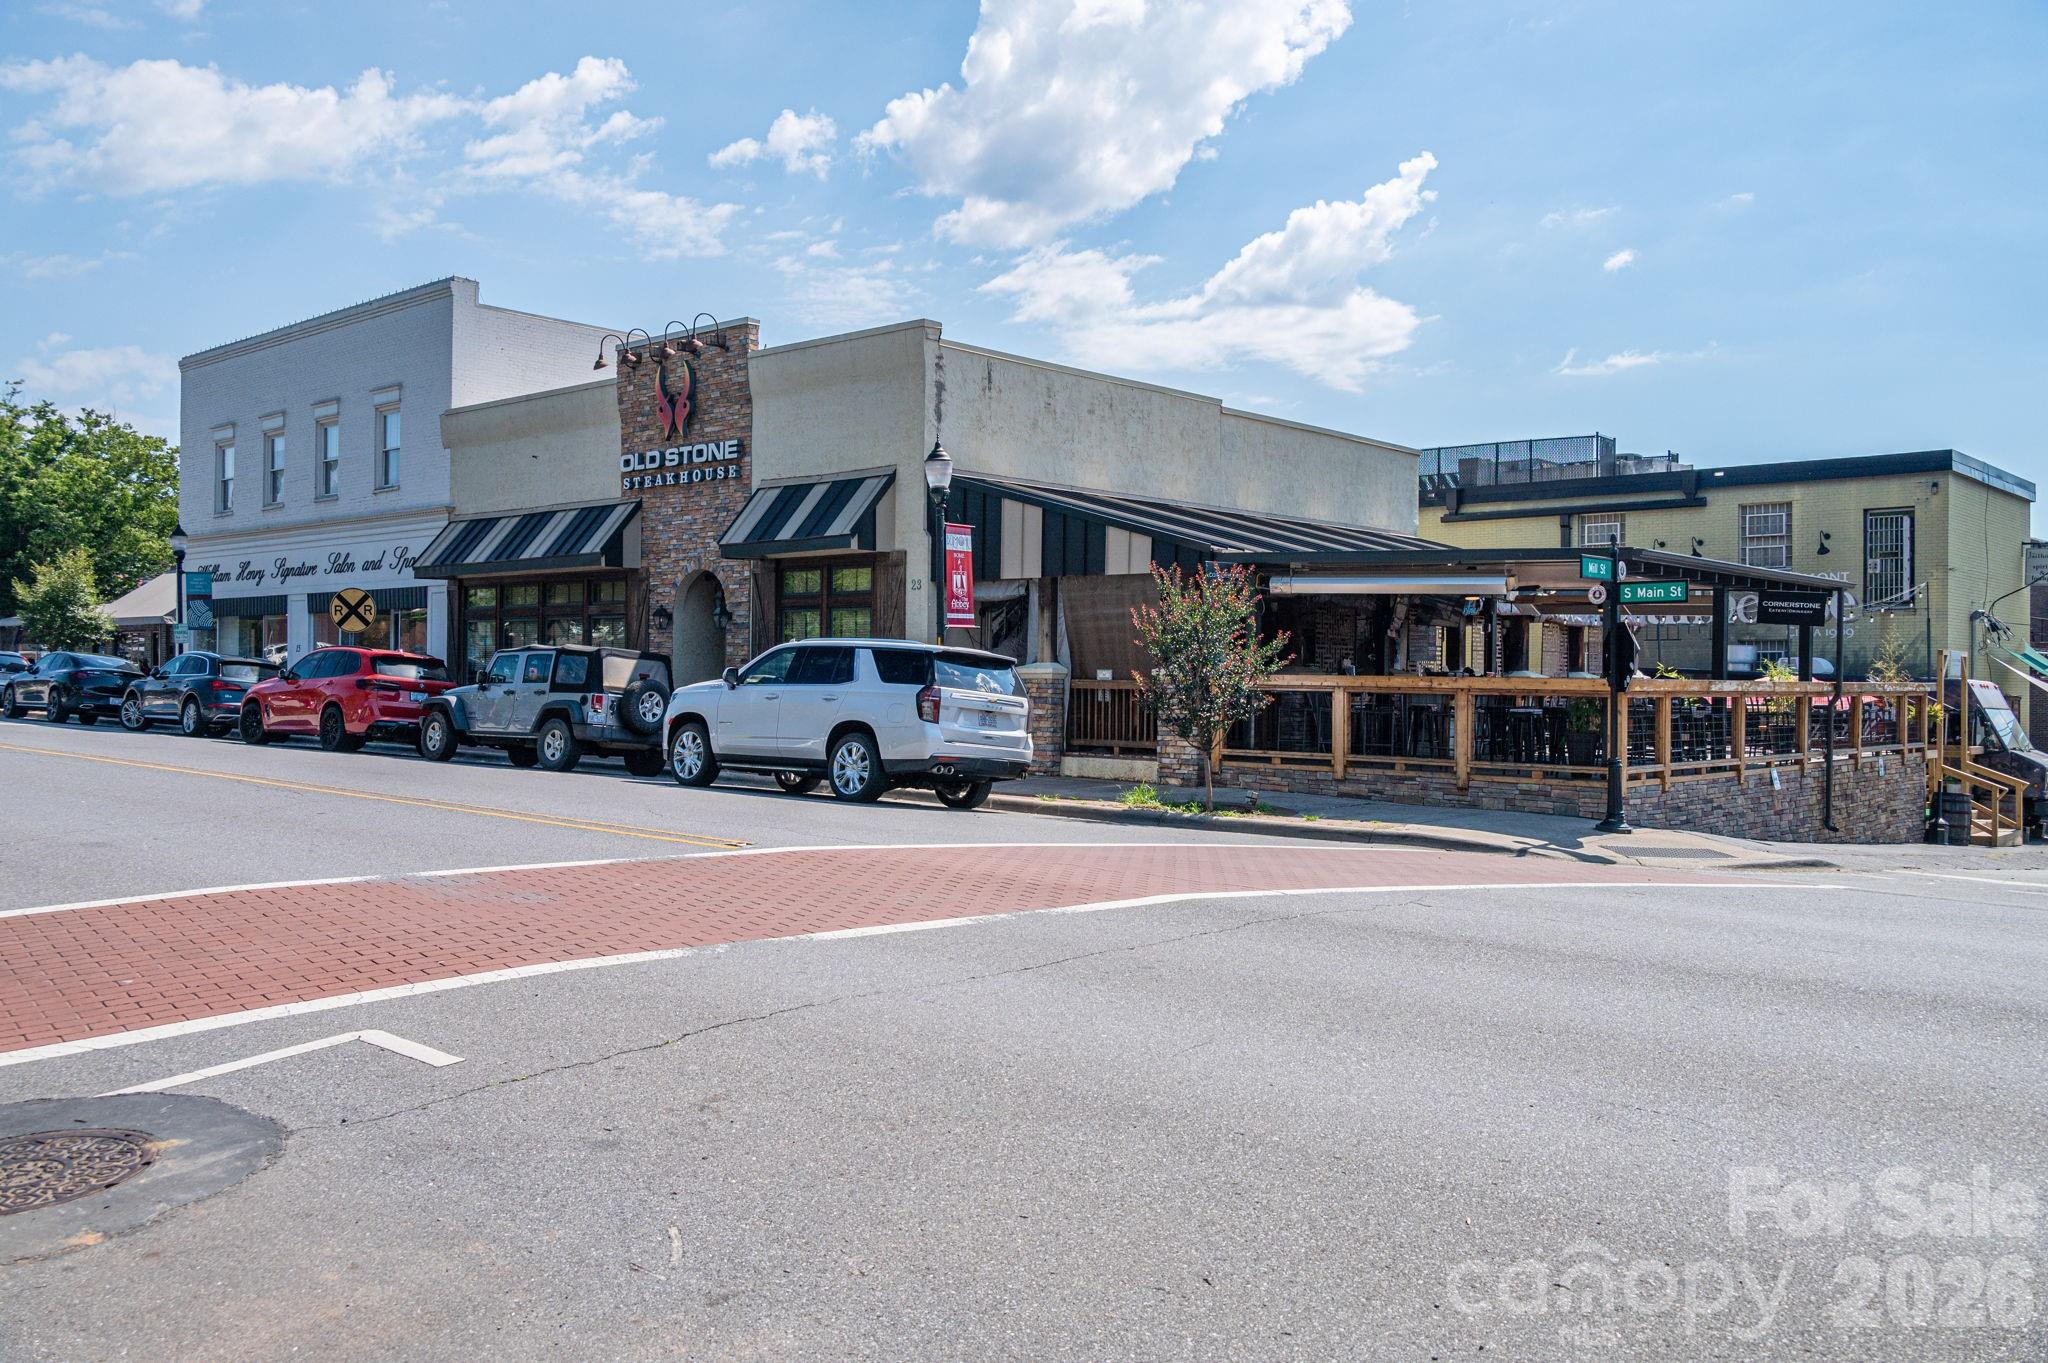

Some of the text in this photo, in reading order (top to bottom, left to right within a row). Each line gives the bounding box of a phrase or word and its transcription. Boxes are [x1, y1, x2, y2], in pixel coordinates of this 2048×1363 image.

[620, 439, 737, 473] OLD STONE
[622, 464, 736, 489] STEAKHOUSE
[236, 560, 265, 587] Henry
[270, 557, 318, 585] Signature
[324, 551, 356, 575] Salon
[362, 549, 383, 571] and
[1588, 561, 1598, 573] Mill
[1600, 563, 1606, 575] St
[911, 578, 922, 591] 23
[1624, 585, 1682, 598] S Main St
[334, 604, 374, 616] R R
[1762, 600, 1822, 609] CORNERSTONE
